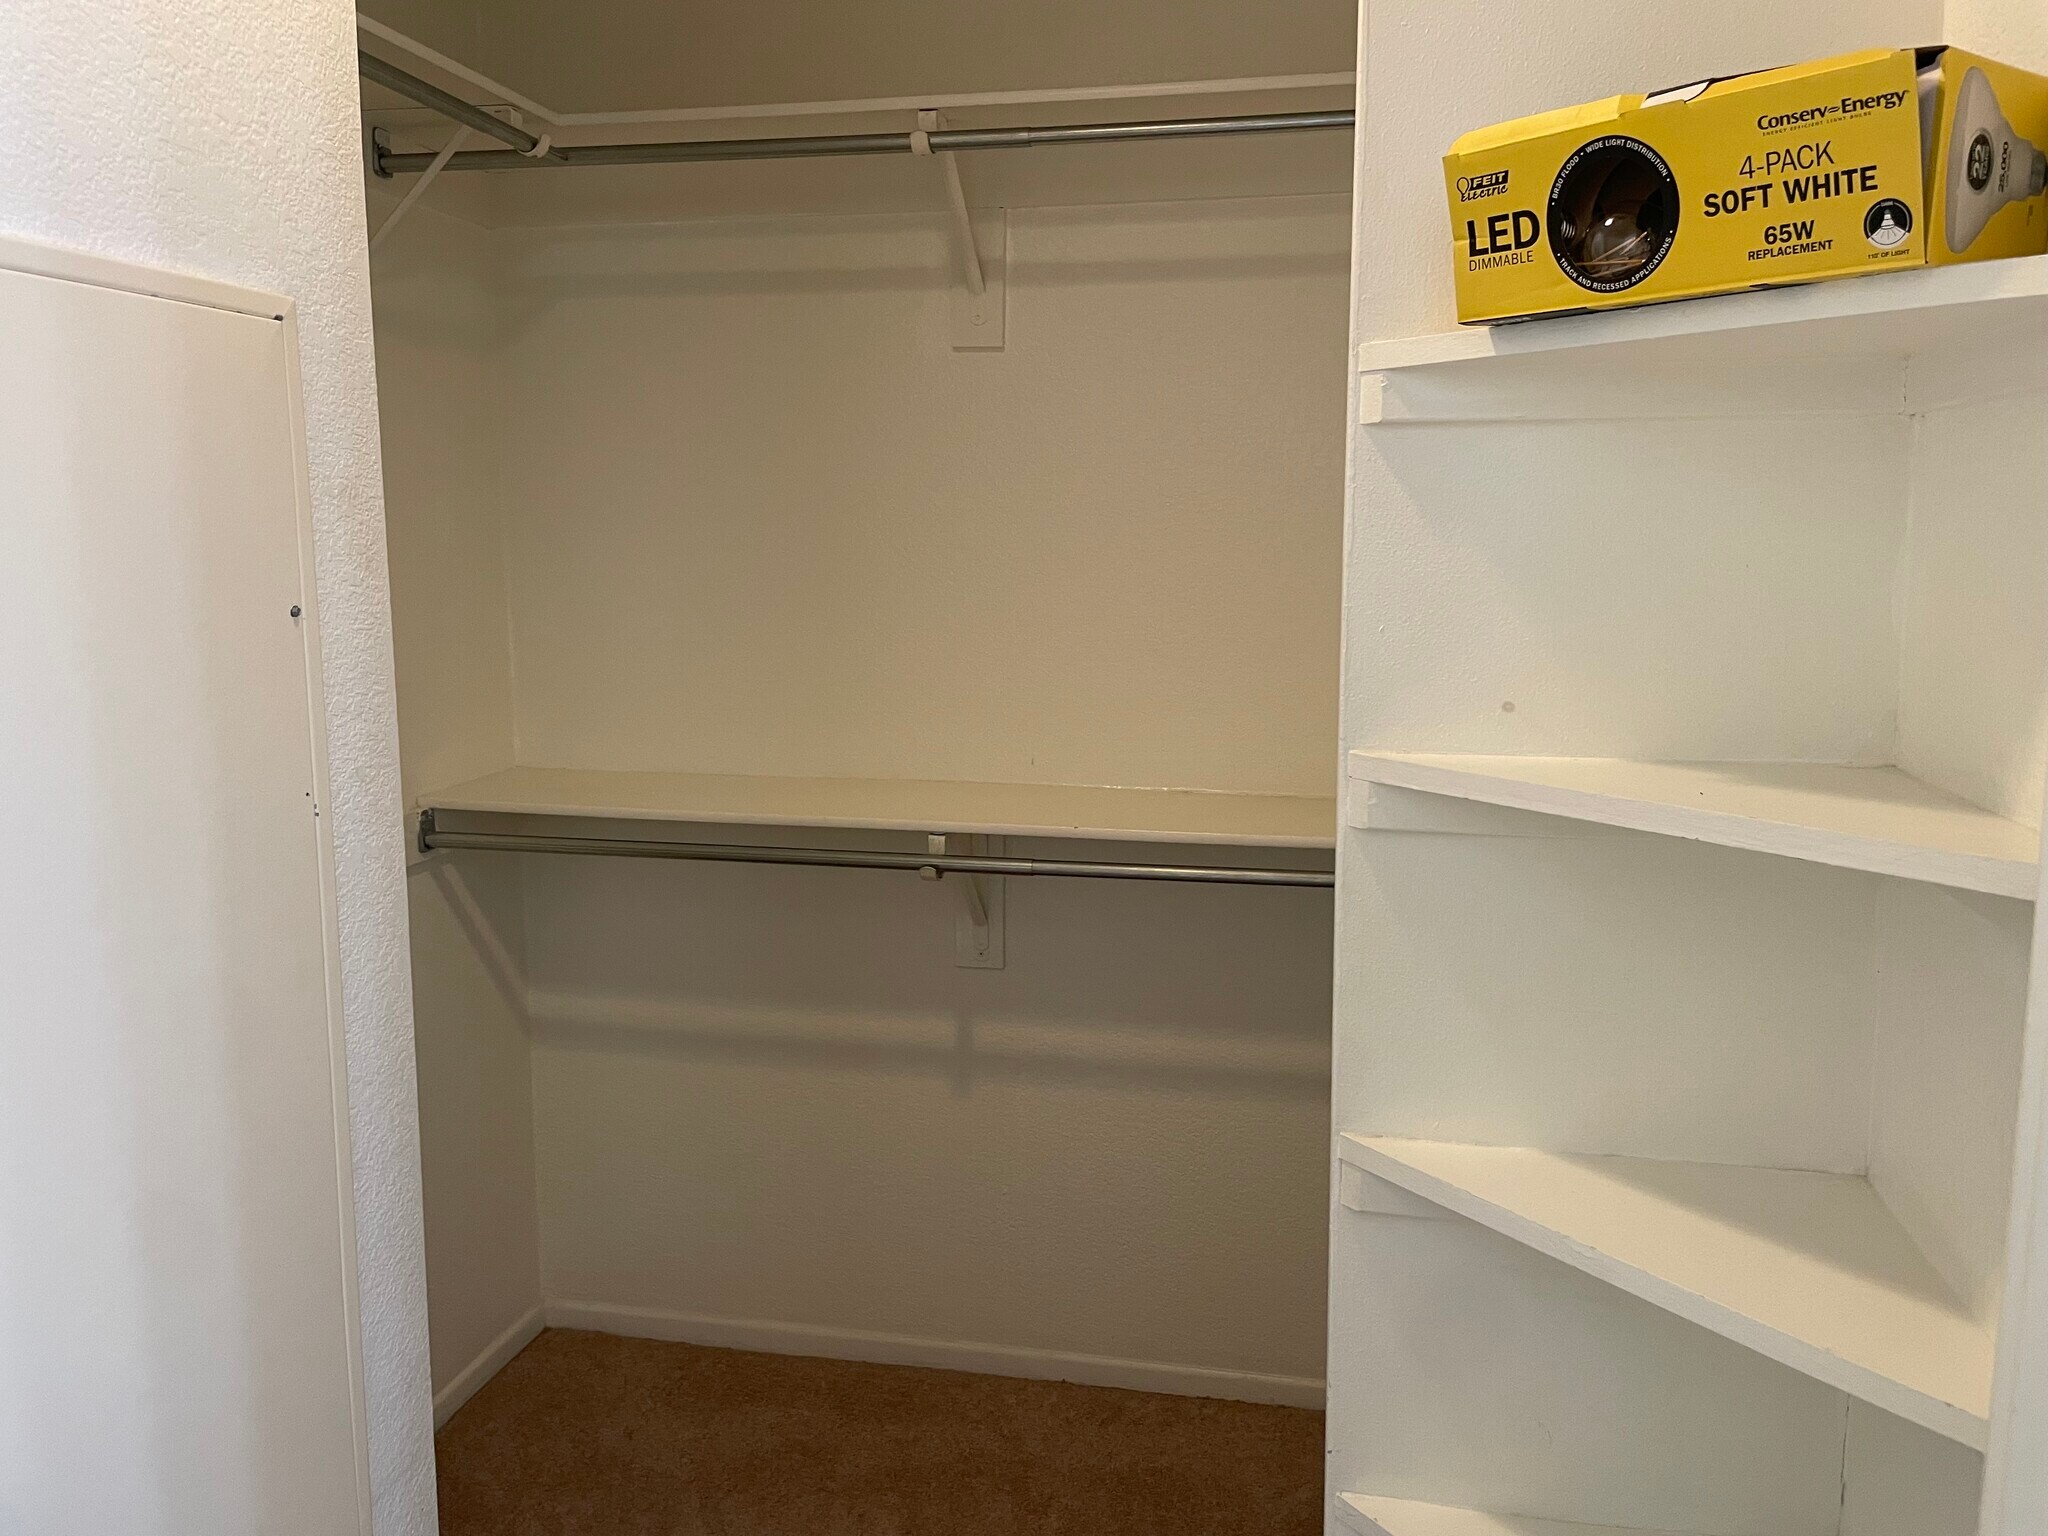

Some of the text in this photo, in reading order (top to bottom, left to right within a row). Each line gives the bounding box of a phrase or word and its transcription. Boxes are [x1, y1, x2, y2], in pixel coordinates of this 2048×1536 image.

[1551, 155, 1579, 199] BR30 FLOOD
[1585, 138, 1668, 177] WIDE LIGHT DISTRIBUTION
[1739, 140, 1835, 179] 4-PACK
[1473, 172, 1506, 188] FEIT
[1703, 165, 1878, 217] SOFT WHITE
[1467, 209, 1540, 257] LED
[1747, 239, 1834, 261] REPLACEMENT
[1764, 219, 1815, 245] 65W
[1469, 250, 1534, 272] DIMMABLE
[1560, 236, 1672, 290] TRACK AND RECESSED APPLICATIONS
[1891, 249, 1910, 257] LIGHT
